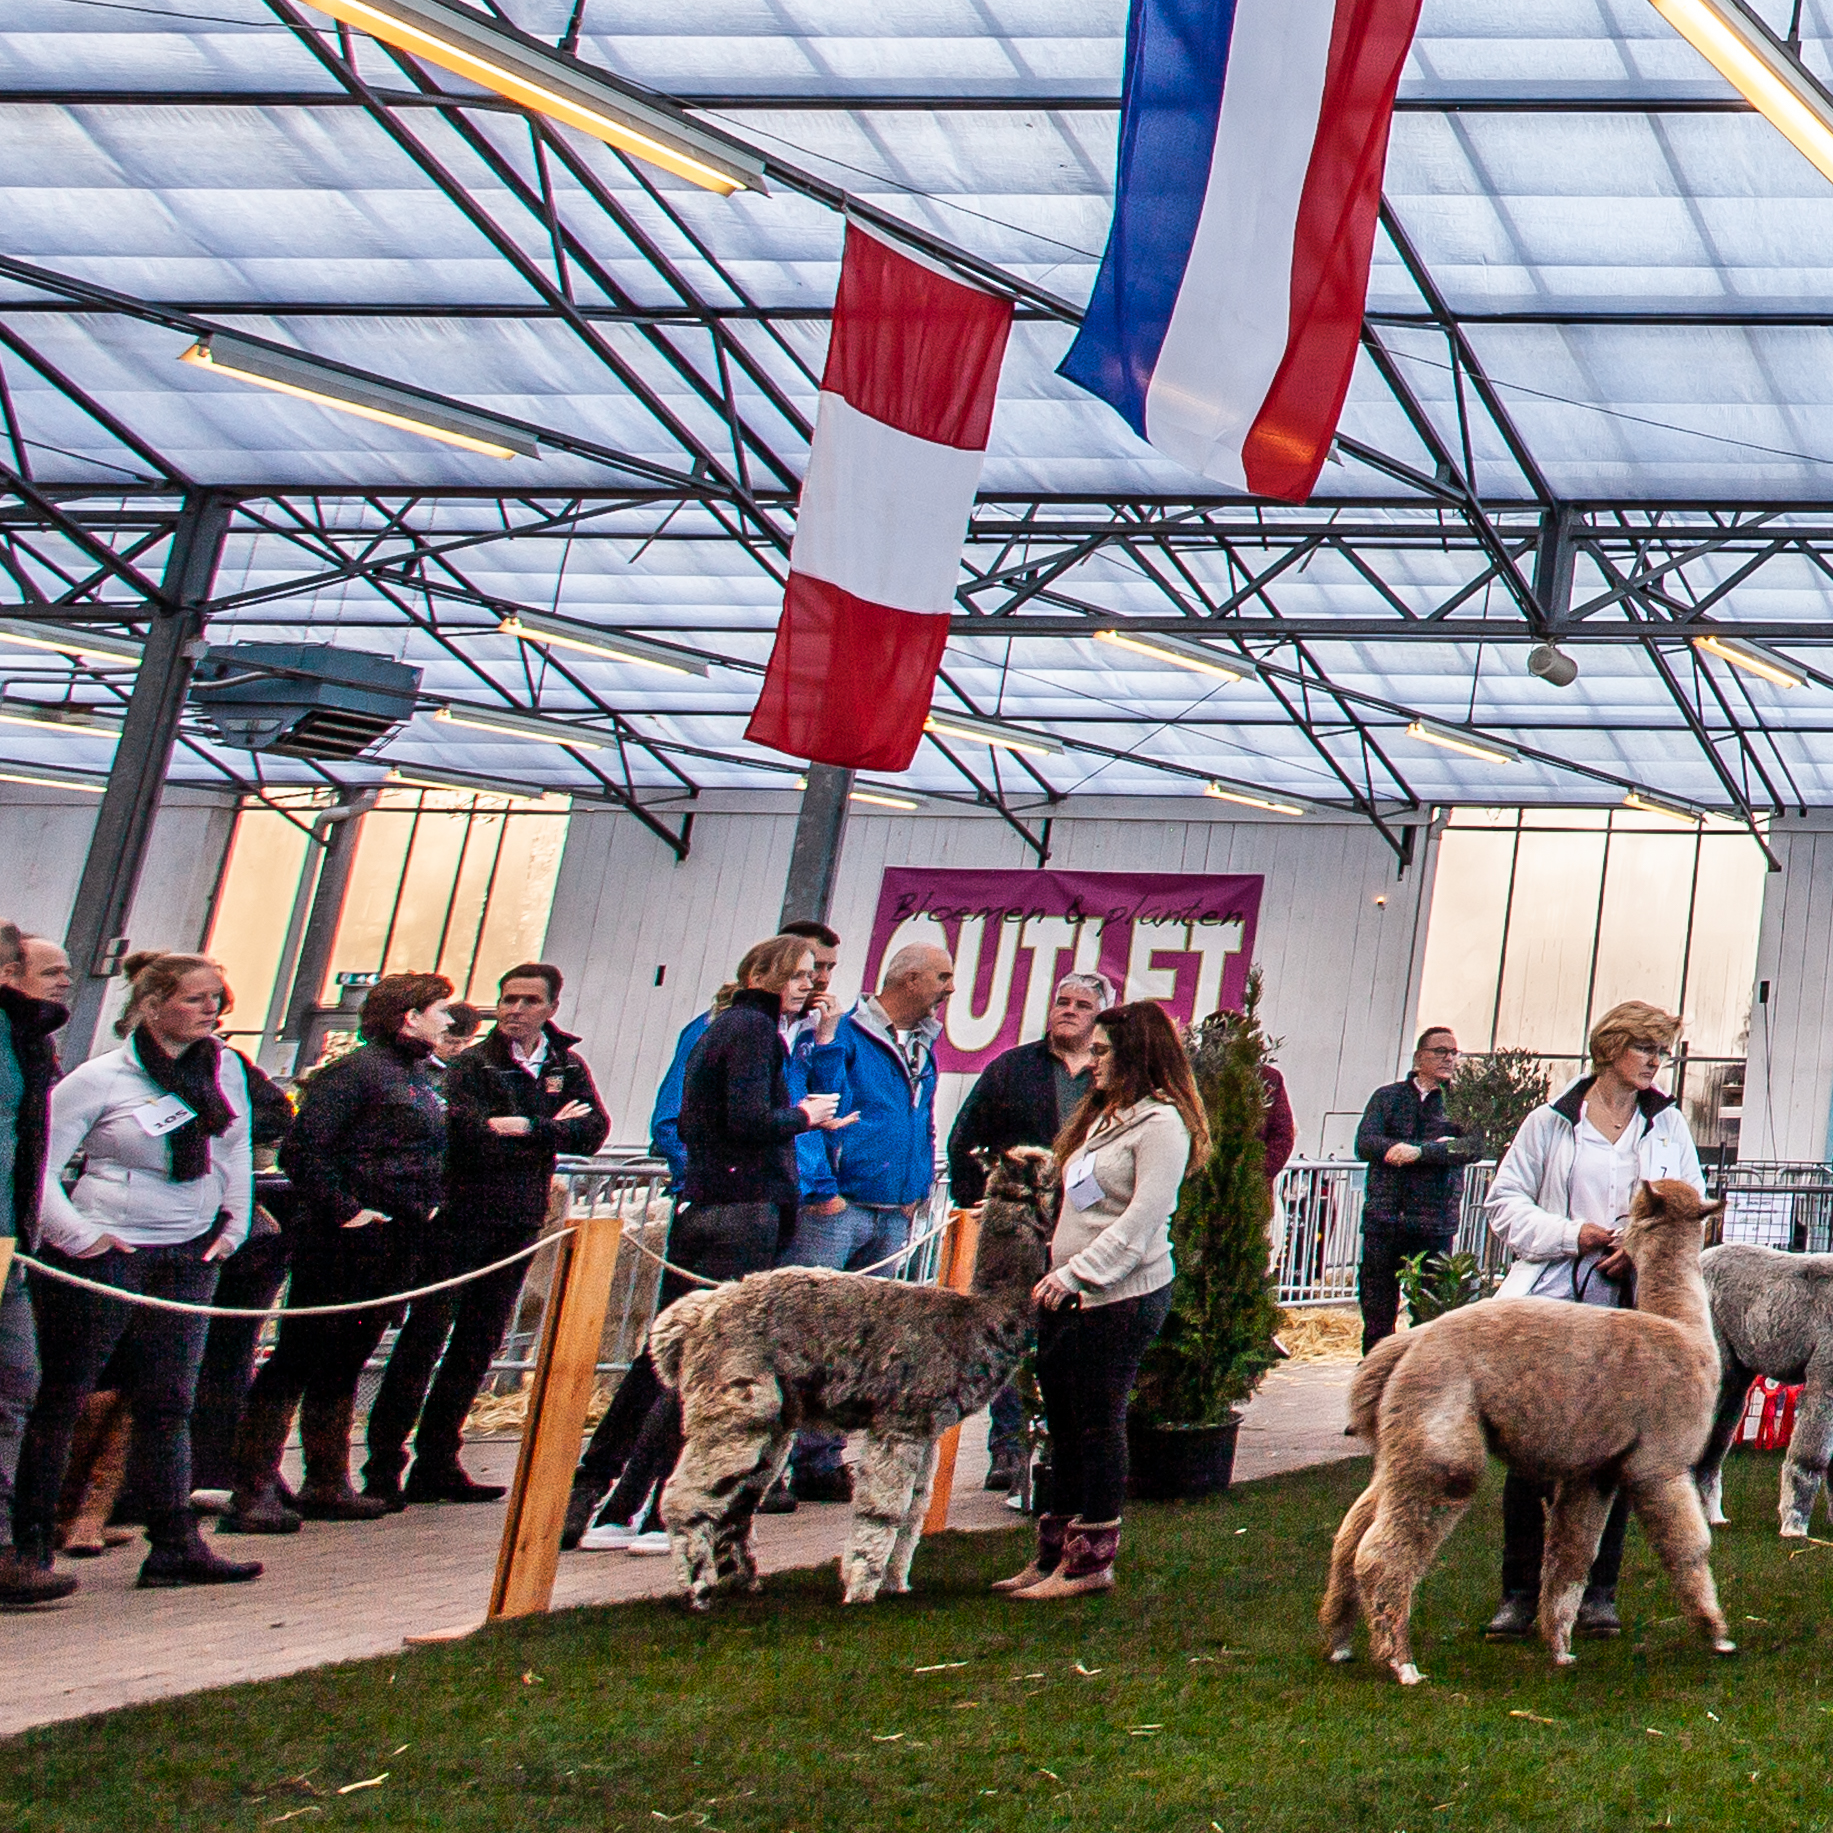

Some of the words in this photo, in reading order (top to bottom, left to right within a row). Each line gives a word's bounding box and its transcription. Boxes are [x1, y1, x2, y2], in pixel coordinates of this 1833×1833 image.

[889, 891, 1047, 925] Bloemen
[1064, 894, 1086, 925] &
[1095, 894, 1244, 937] planten
